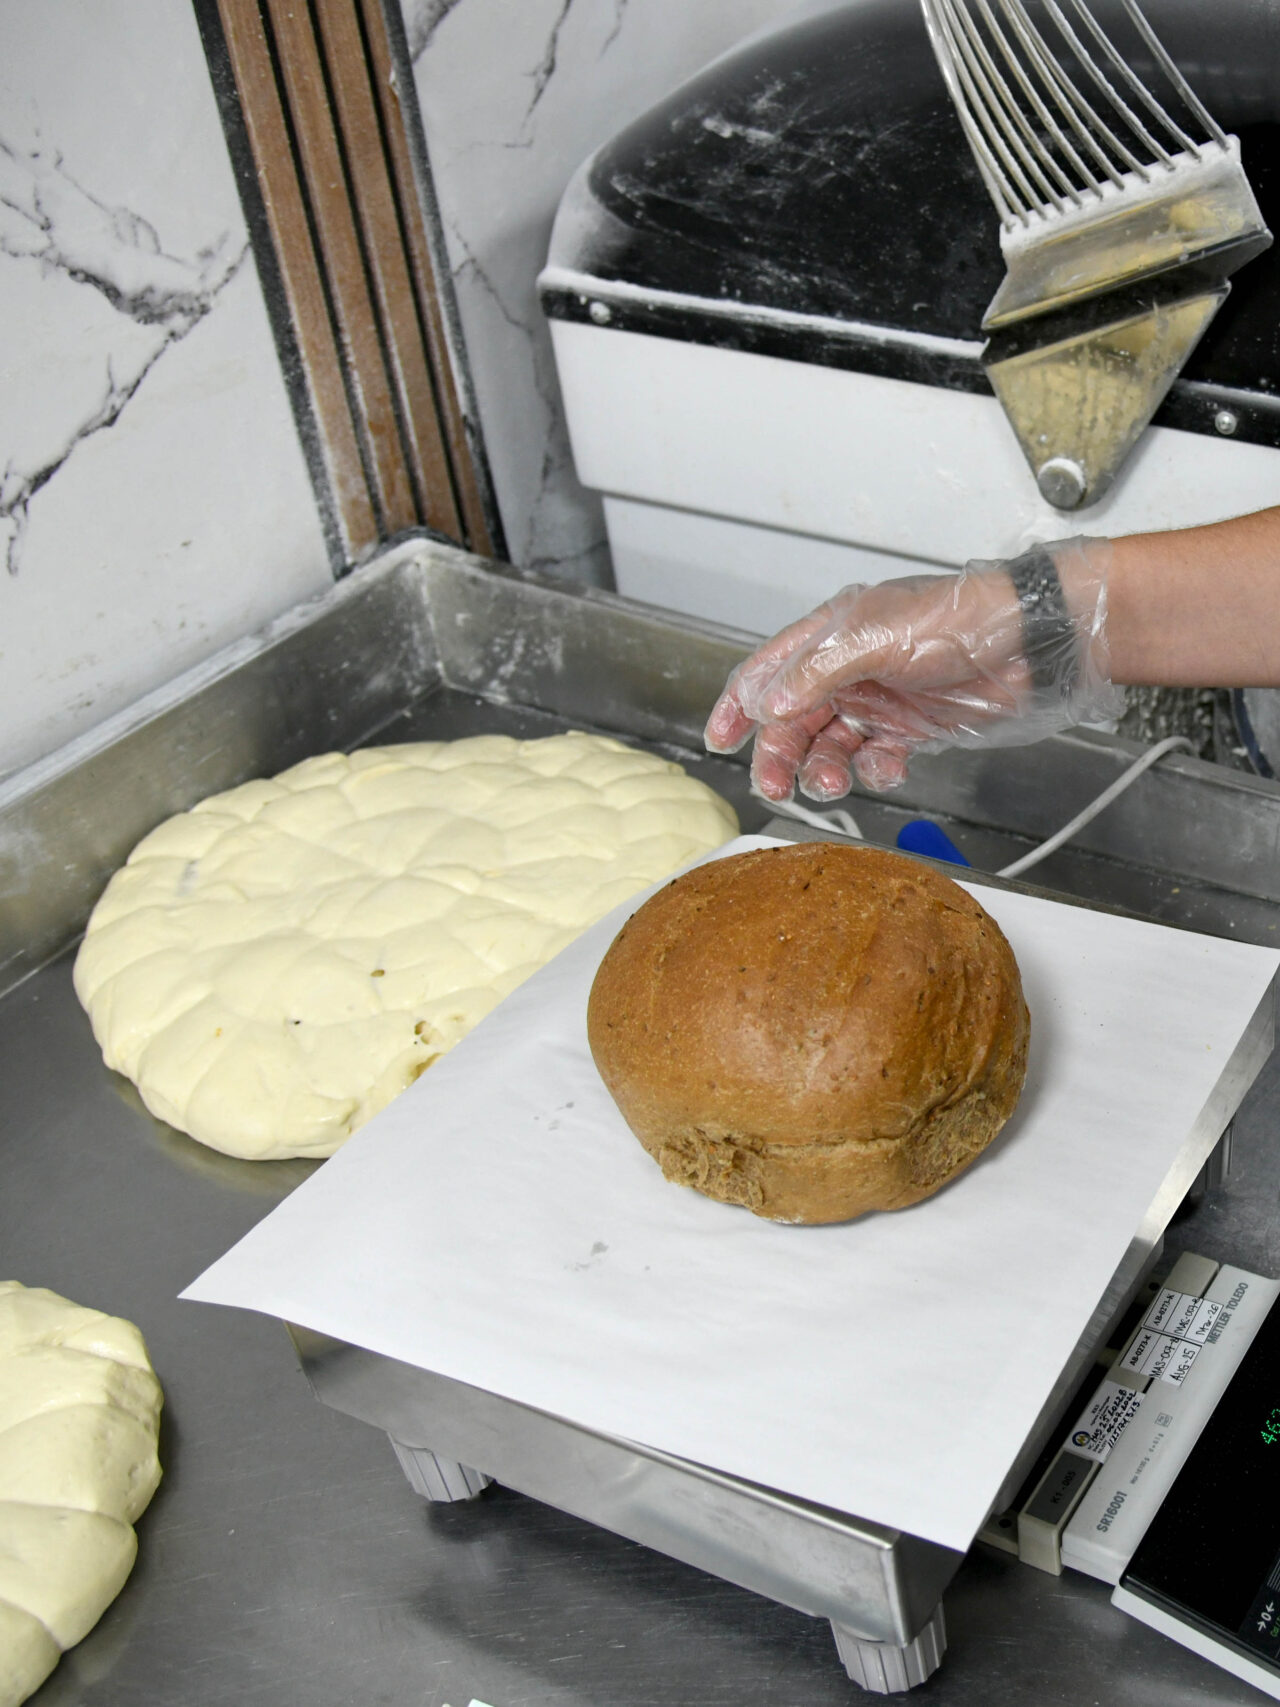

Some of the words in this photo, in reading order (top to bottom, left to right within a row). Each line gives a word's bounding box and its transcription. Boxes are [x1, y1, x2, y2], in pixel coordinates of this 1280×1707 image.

[1153, 1293, 1175, 1326] AB-0273-K
[1207, 1311, 1232, 1345] METTLER
[1225, 1282, 1249, 1310] TOLEDO
[1129, 1334, 1152, 1367] AB-0273-K
[1097, 1491, 1127, 1533] SR16001
